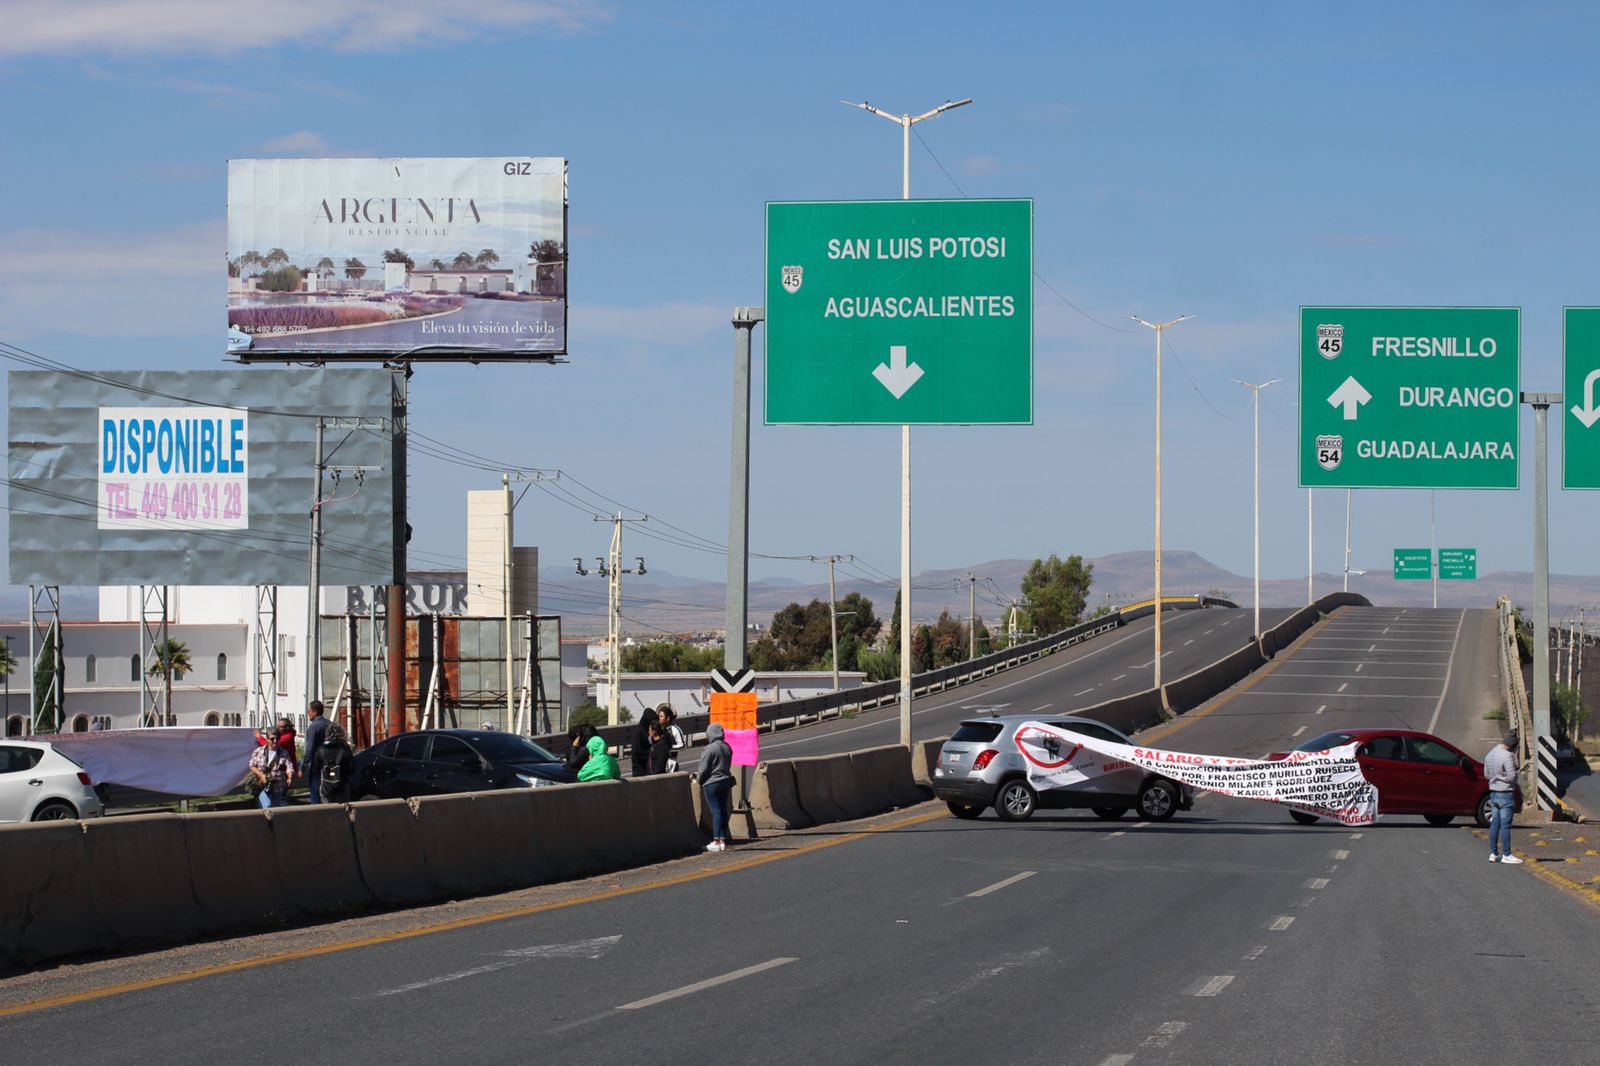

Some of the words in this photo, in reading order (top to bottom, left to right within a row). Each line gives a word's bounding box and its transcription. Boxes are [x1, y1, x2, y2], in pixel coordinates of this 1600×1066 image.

[503, 162, 532, 176] GIZ
[312, 197, 481, 224] ARGENTA
[349, 228, 449, 236] RESIDENCIAL
[827, 238, 870, 259] SAN
[877, 237, 923, 259] LUIS
[929, 236, 1006, 258] POTOSI
[784, 275, 800, 287] 45
[824, 296, 1015, 318] AGUASCALIENTES
[421, 320, 455, 334] Eleva
[457, 321, 470, 334] tu
[470, 320, 509, 334] visión
[511, 320, 526, 334] de
[527, 320, 555, 334] vida
[1319, 329, 1343, 337] MEXICO
[1320, 339, 1340, 352] 45
[1371, 336, 1497, 358] FRESNILLO
[1399, 386, 1514, 408] DURANGO
[103, 418, 244, 475] DISPONIBLE
[1318, 439, 1342, 447] MEXICO
[1356, 439, 1515, 460] GUADALAJARA
[1319, 450, 1340, 464] 54
[105, 483, 137, 519] TEL.
[141, 482, 168, 519] 449
[171, 482, 198, 519] 400
[202, 482, 219, 519] 31
[223, 482, 241, 519] 28
[1134, 748, 1203, 764] SALARIO
[1208, 772, 1266, 781] FRANCISCO
[1269, 768, 1312, 779] MURILLO
[1315, 765, 1356, 775] RUISECO
[1228, 780, 1273, 789] MILANES
[1276, 774, 1332, 787] RODRIGUEZ
[1275, 786, 1305, 796] ANAHI
